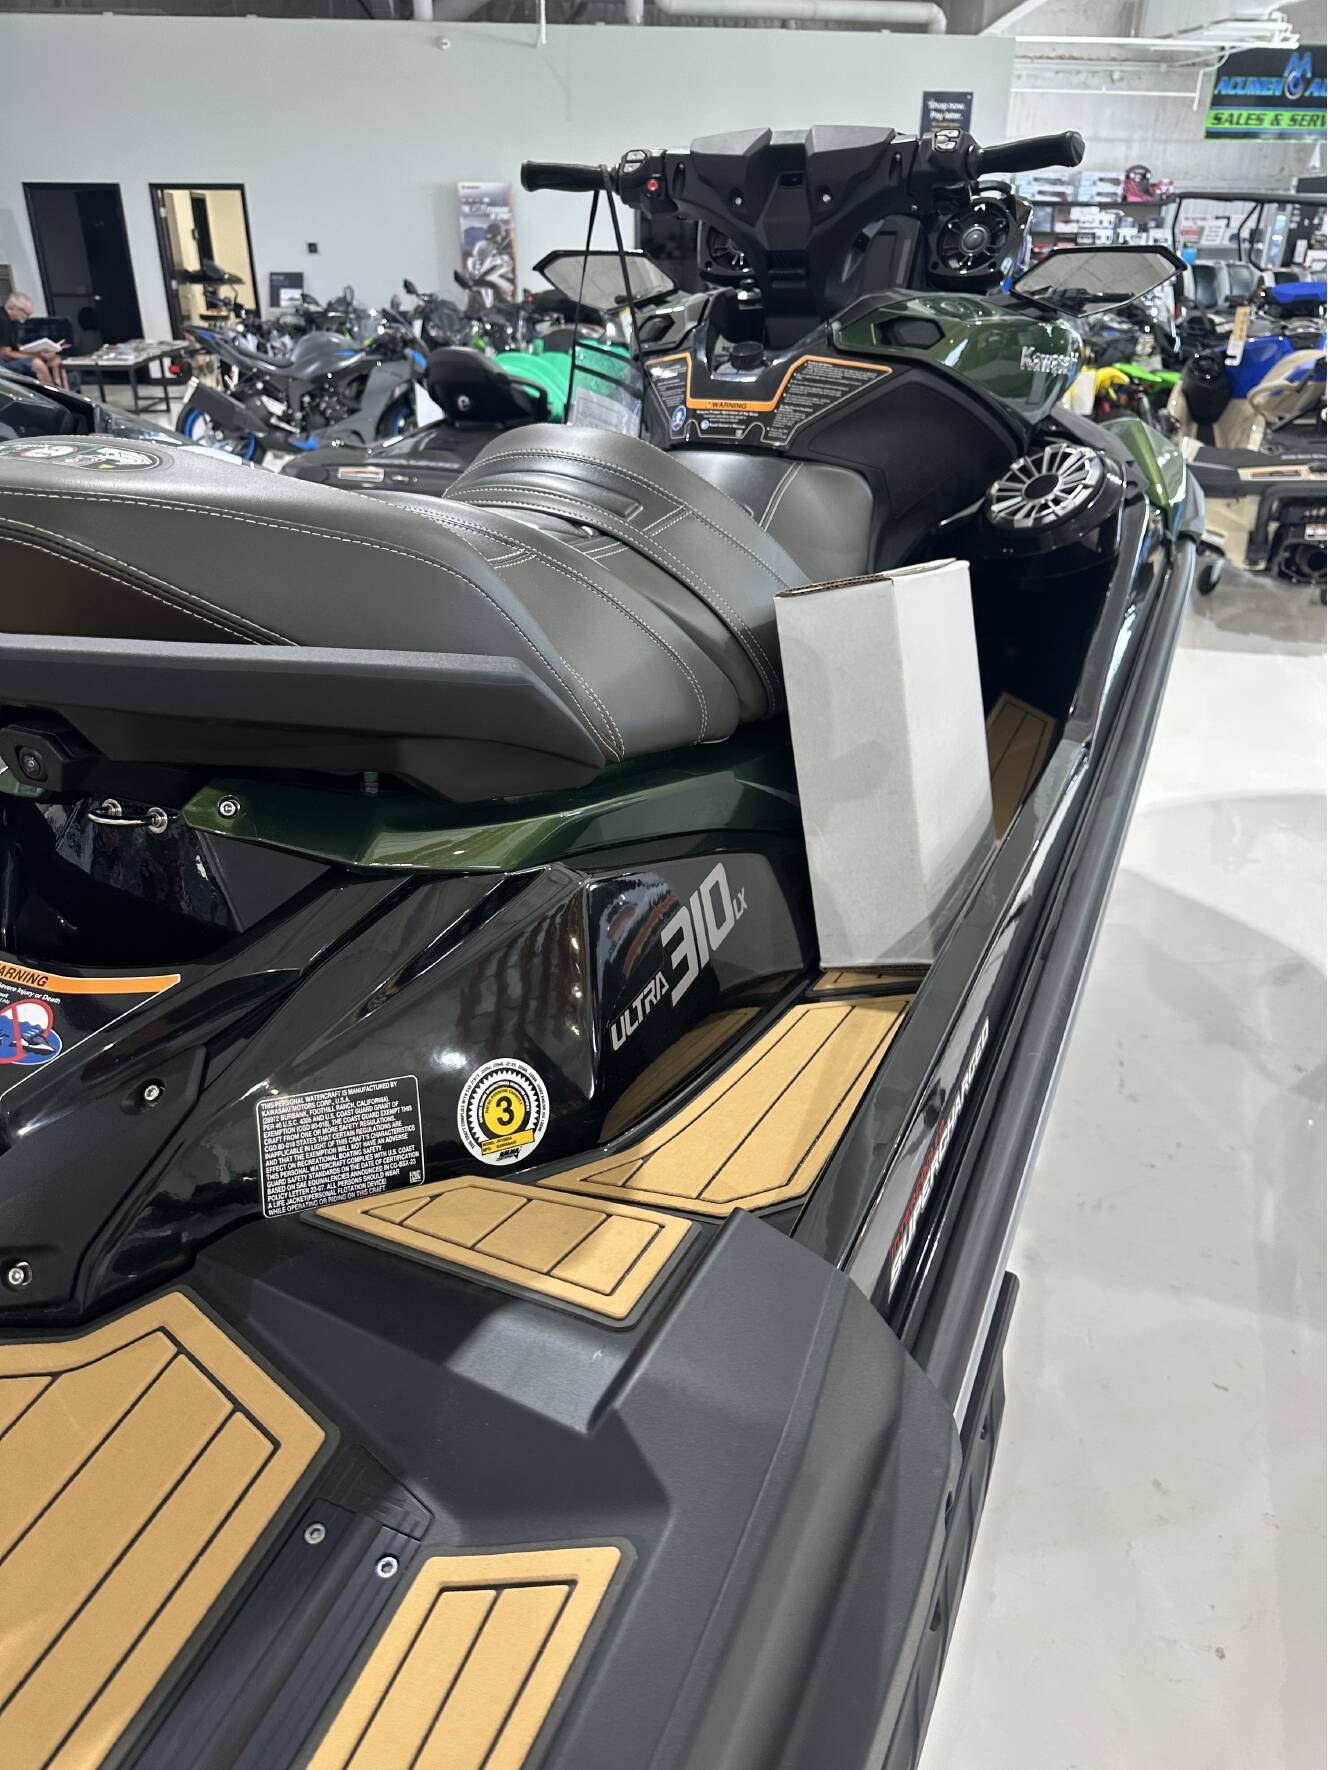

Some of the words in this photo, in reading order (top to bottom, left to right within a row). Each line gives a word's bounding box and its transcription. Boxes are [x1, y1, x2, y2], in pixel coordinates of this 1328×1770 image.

[1212, 112, 1265, 126] SALES
[1269, 113, 1284, 126] &
[732, 887, 747, 920] LX
[661, 862, 736, 1007] 310
[17, 987, 34, 997] Injury
[42, 994, 61, 1004] Death
[609, 971, 669, 1051] ULTRA
[496, 1096, 514, 1126] 3
[888, 1015, 989, 1304] SUPERCHARGED
